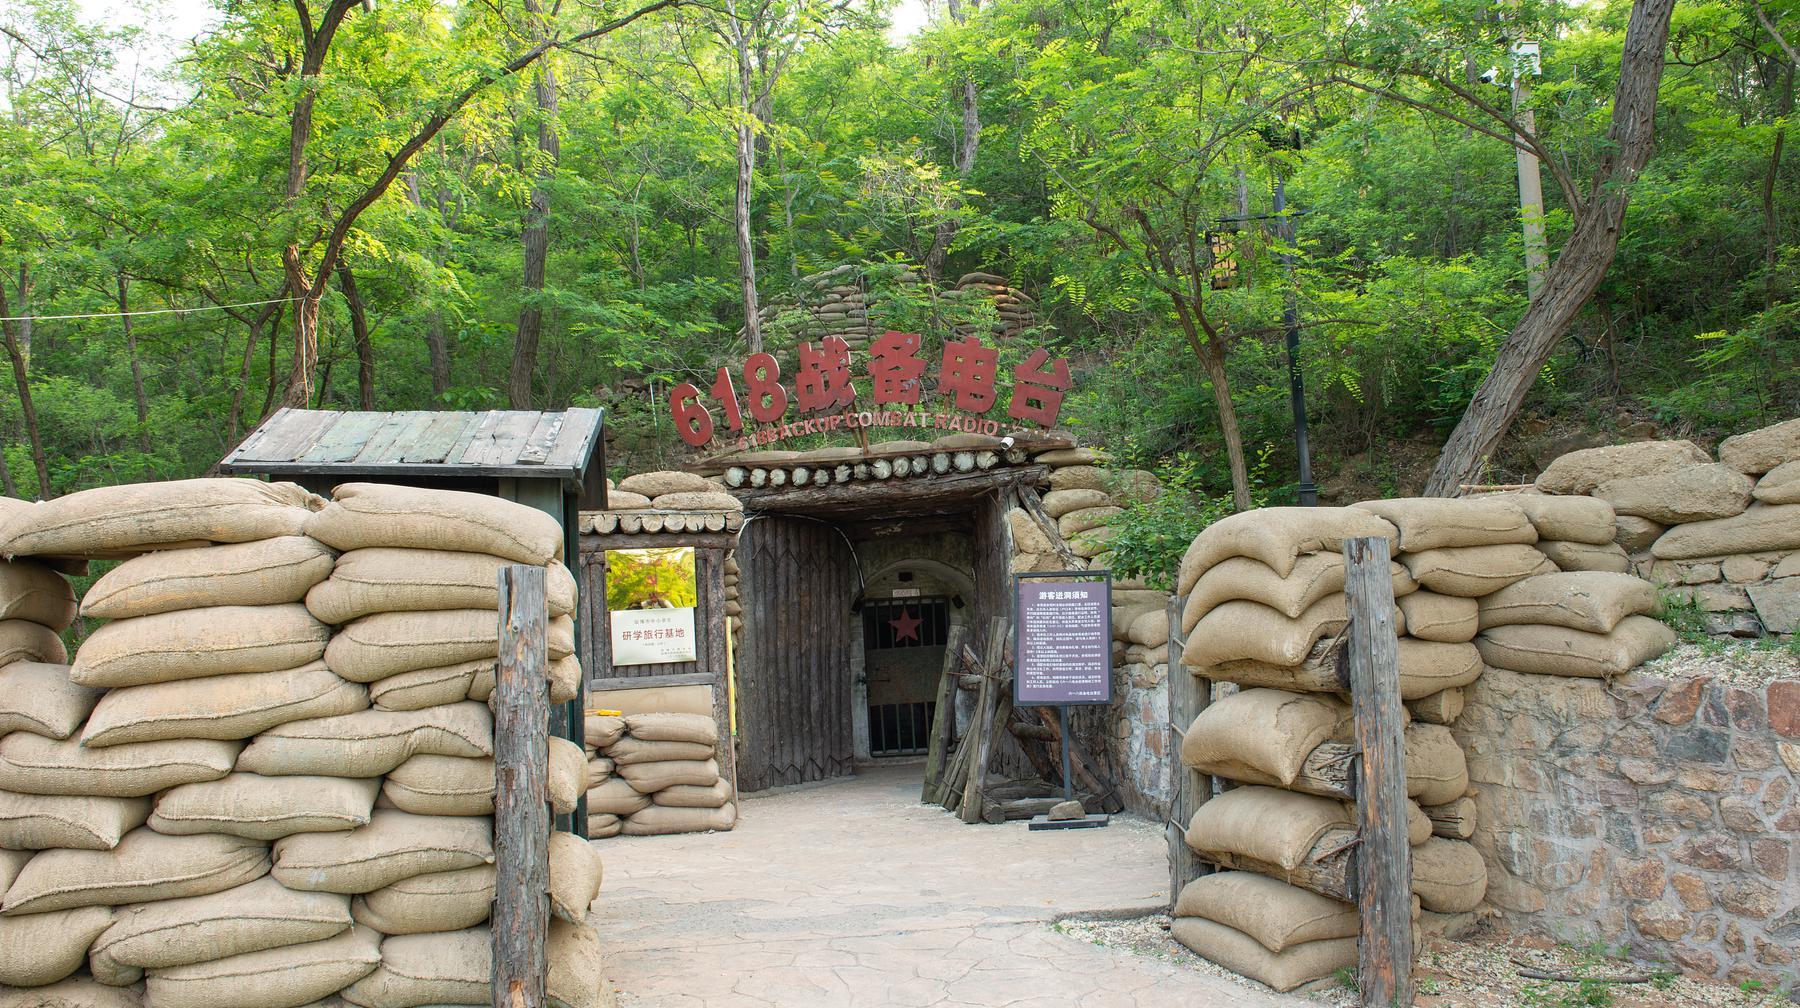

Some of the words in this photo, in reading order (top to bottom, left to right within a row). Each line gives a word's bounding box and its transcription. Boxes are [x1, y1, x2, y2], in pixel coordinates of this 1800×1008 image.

[670, 330, 1073, 447] 618战备电台
[846, 412, 931, 428] COMBAT
[934, 414, 999, 436] RADIO
[1039, 591, 1088, 600] 游客进洞须知
[622, 627, 685, 641] 研学旅行基地
